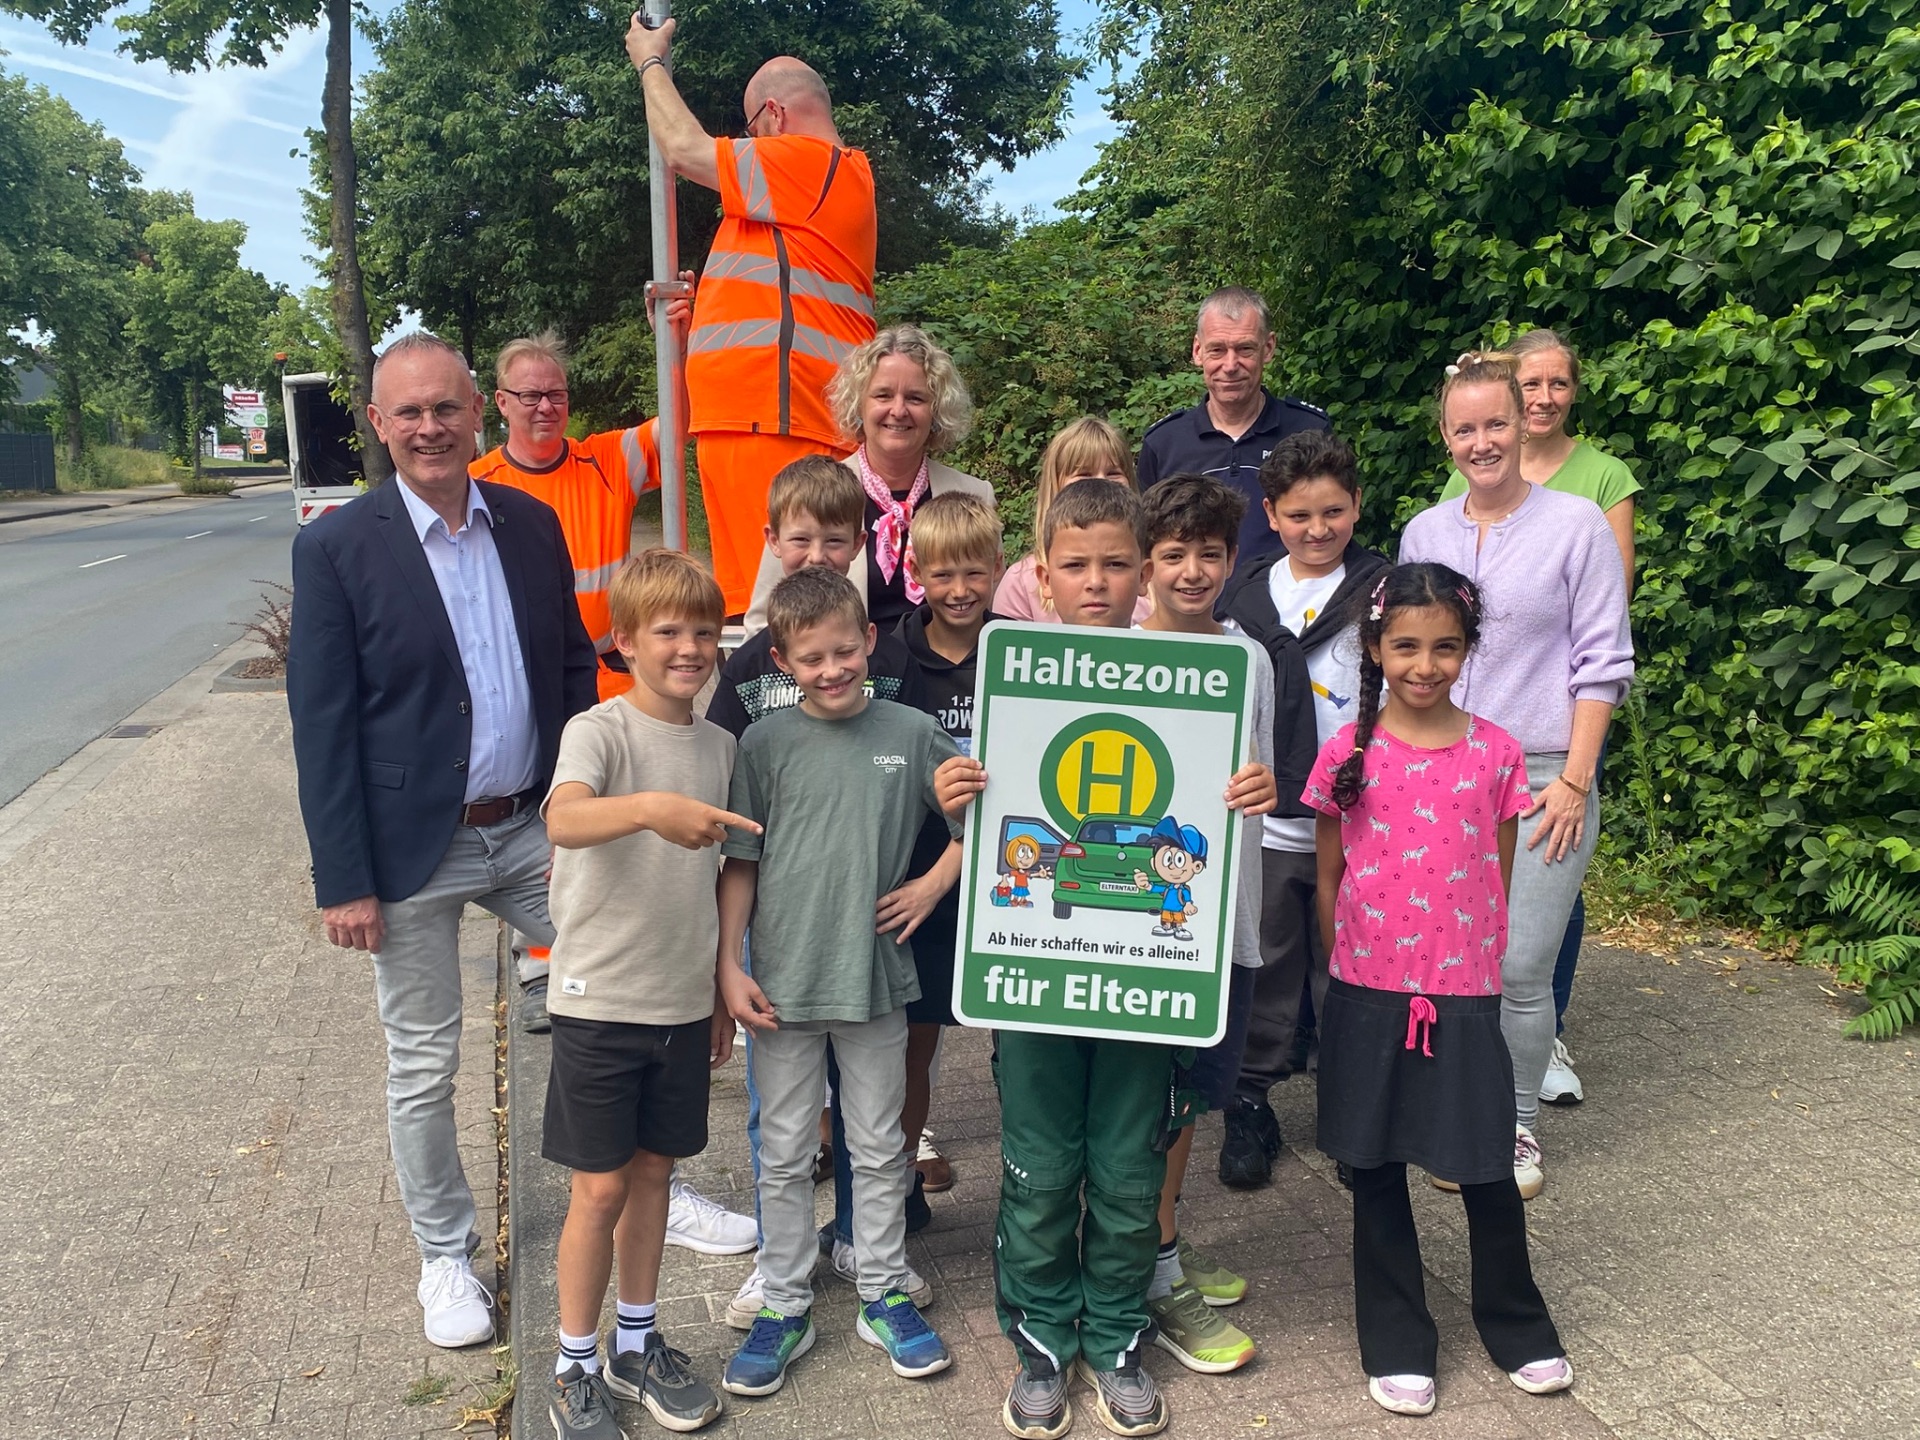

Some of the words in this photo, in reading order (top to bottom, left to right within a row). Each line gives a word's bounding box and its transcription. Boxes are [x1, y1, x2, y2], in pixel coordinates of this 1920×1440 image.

[1003, 646, 1229, 698] Haltezone
[951, 695, 973, 707] 1.F
[937, 709, 972, 729] RDW
[873, 755, 908, 765] COASTAL
[1078, 741, 1136, 815] H
[988, 931, 1007, 945] Ab
[1010, 933, 1038, 948] hier
[1041, 936, 1099, 953] schaffen
[1103, 941, 1126, 956] wir
[1129, 945, 1144, 957] es
[1148, 944, 1200, 962] alleine!
[983, 965, 1050, 1007] für
[1063, 973, 1197, 1020] Eltern
